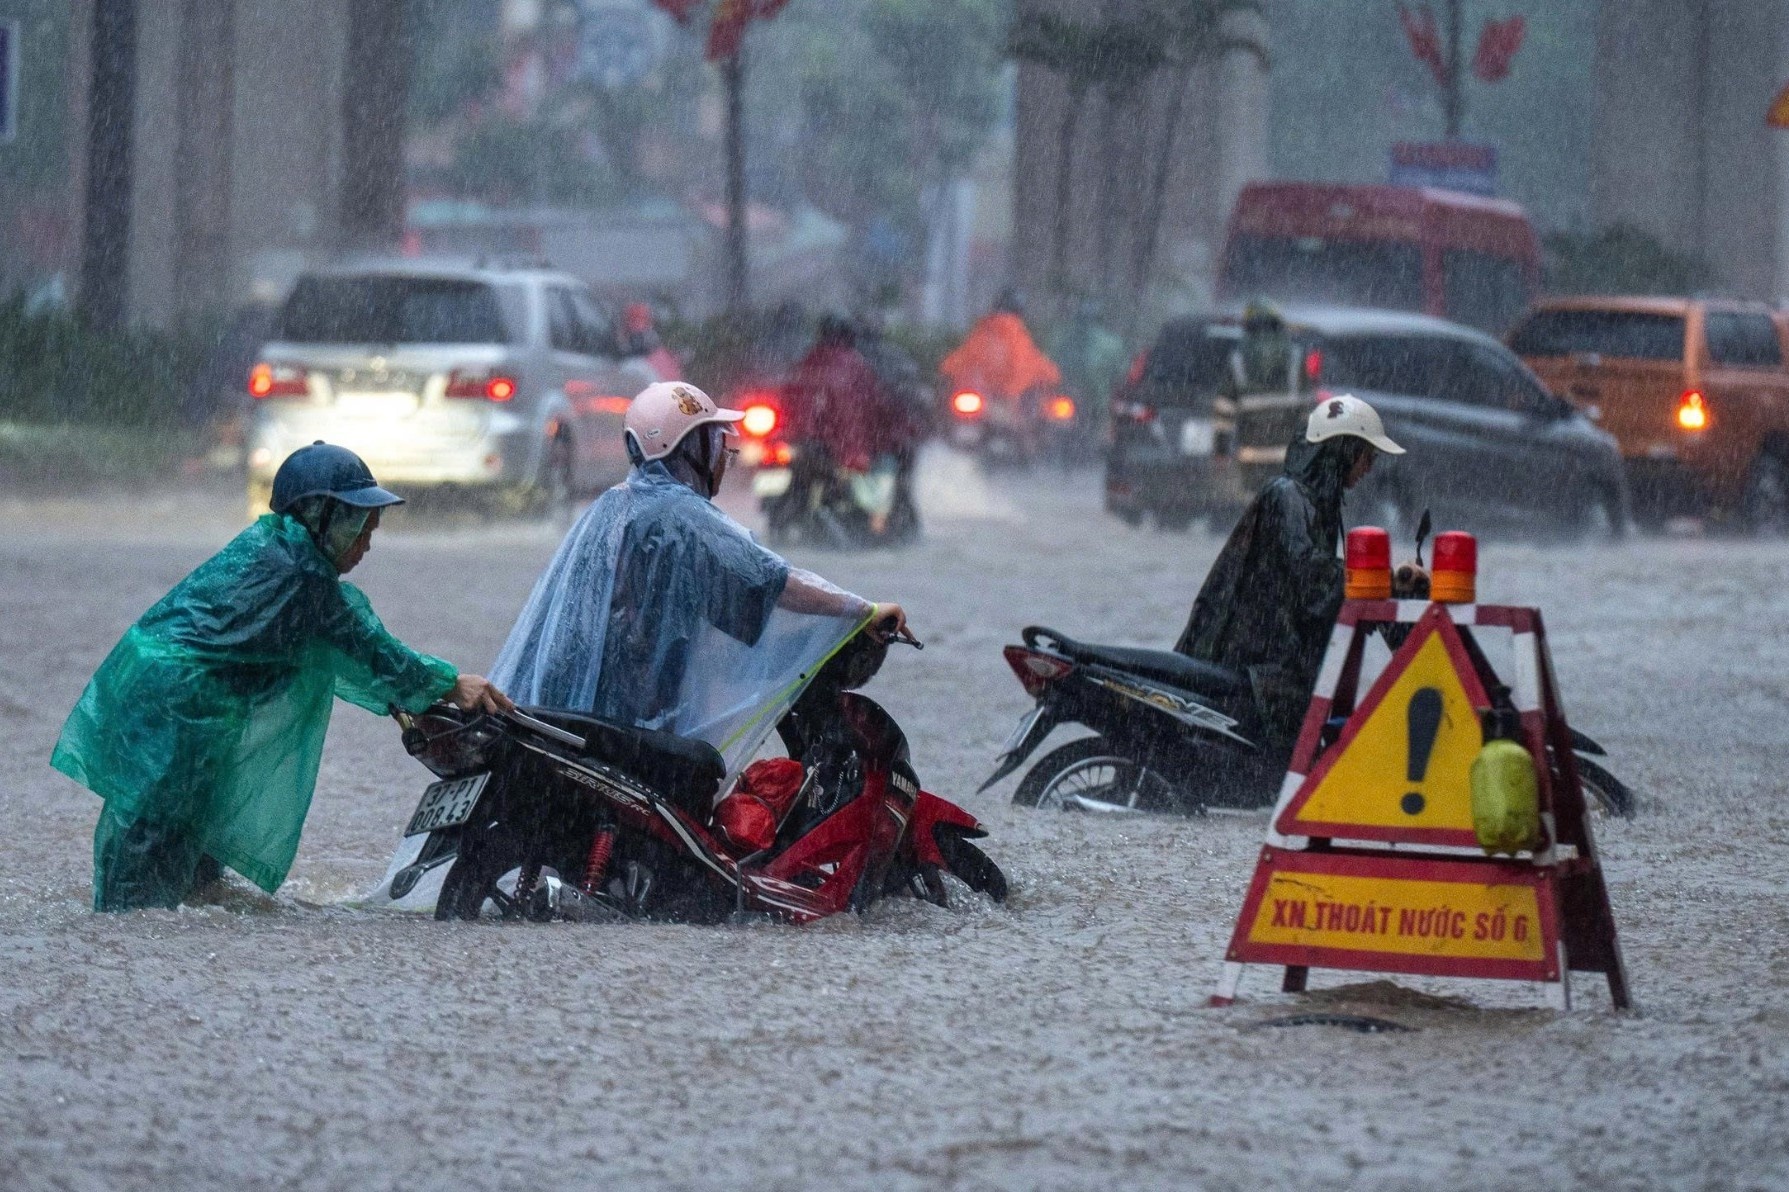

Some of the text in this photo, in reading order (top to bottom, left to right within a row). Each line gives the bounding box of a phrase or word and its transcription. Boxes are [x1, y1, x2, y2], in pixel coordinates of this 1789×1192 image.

[1271, 899, 1529, 943] XN THOÁT NƯỚC SỐ 6
